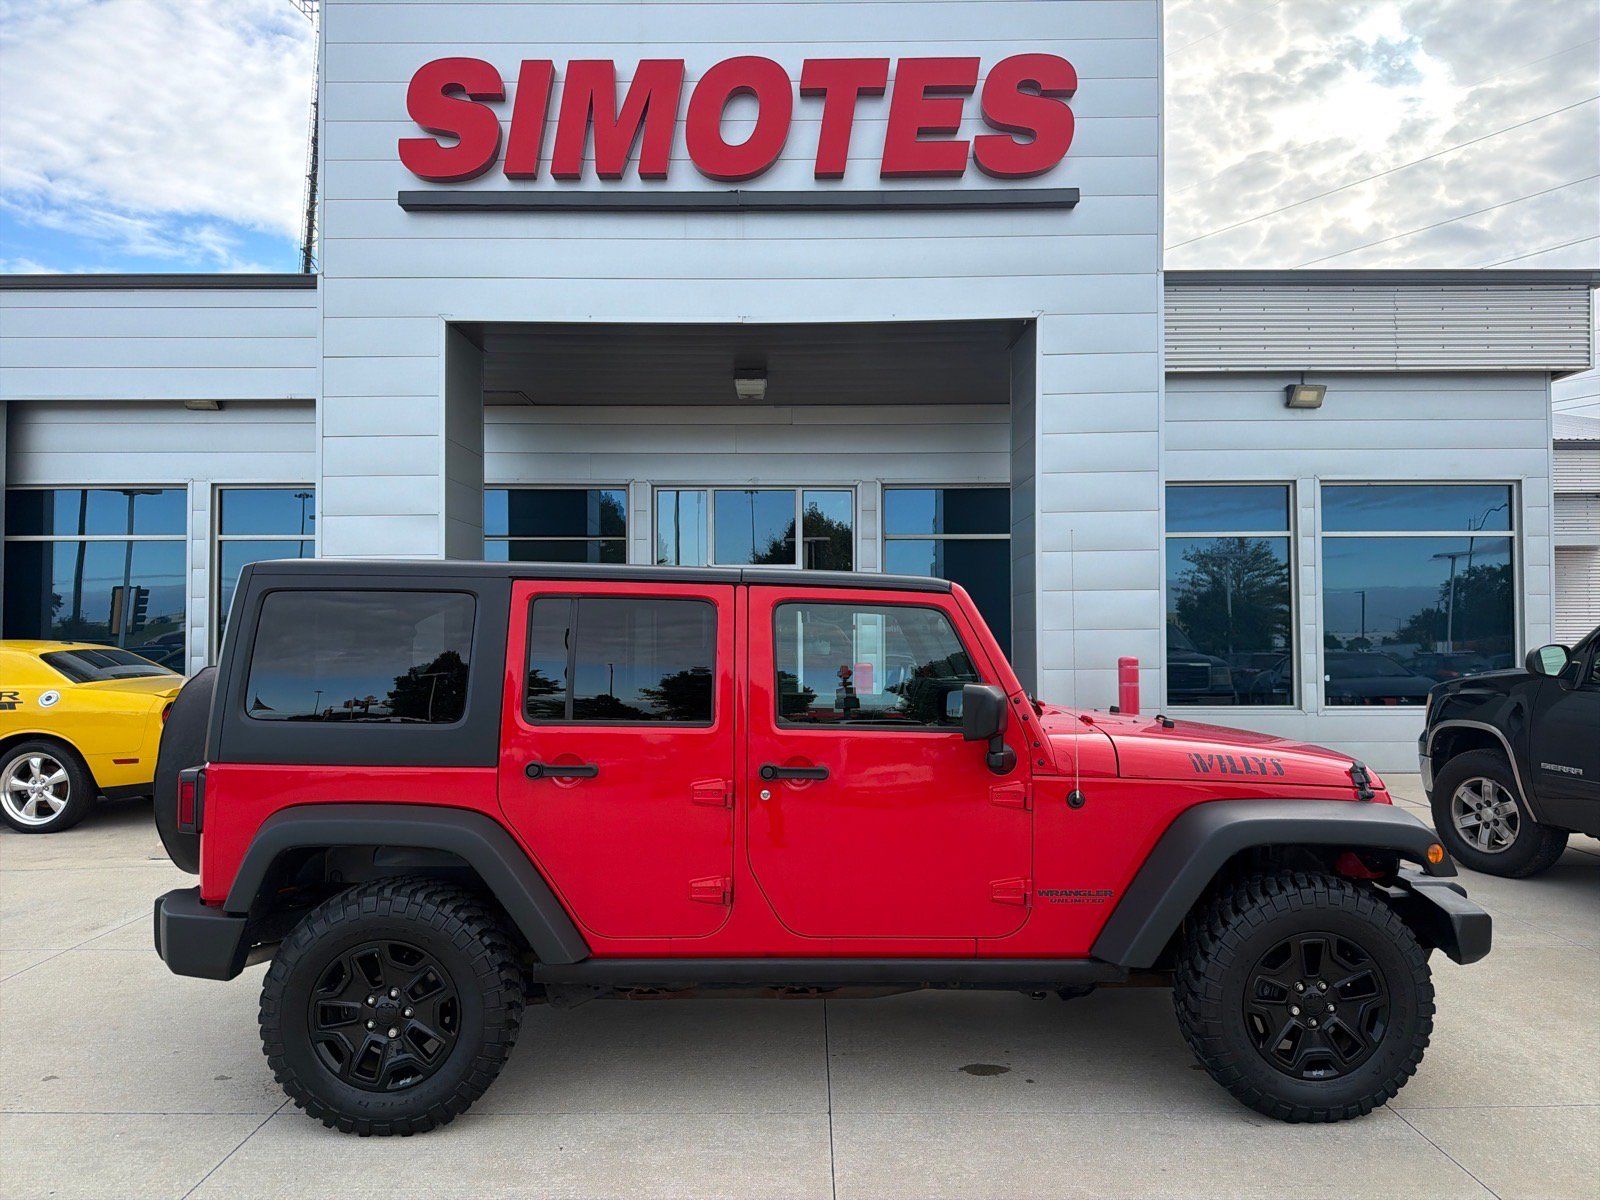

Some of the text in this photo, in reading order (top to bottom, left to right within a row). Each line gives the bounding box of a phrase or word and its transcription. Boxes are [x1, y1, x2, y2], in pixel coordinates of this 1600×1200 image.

[398, 53, 1078, 183] SIMOTES
[1187, 752, 1285, 777] WILLYS
[1540, 762, 1583, 776] SIERRA
[1037, 888, 1114, 897] WRANGLER
